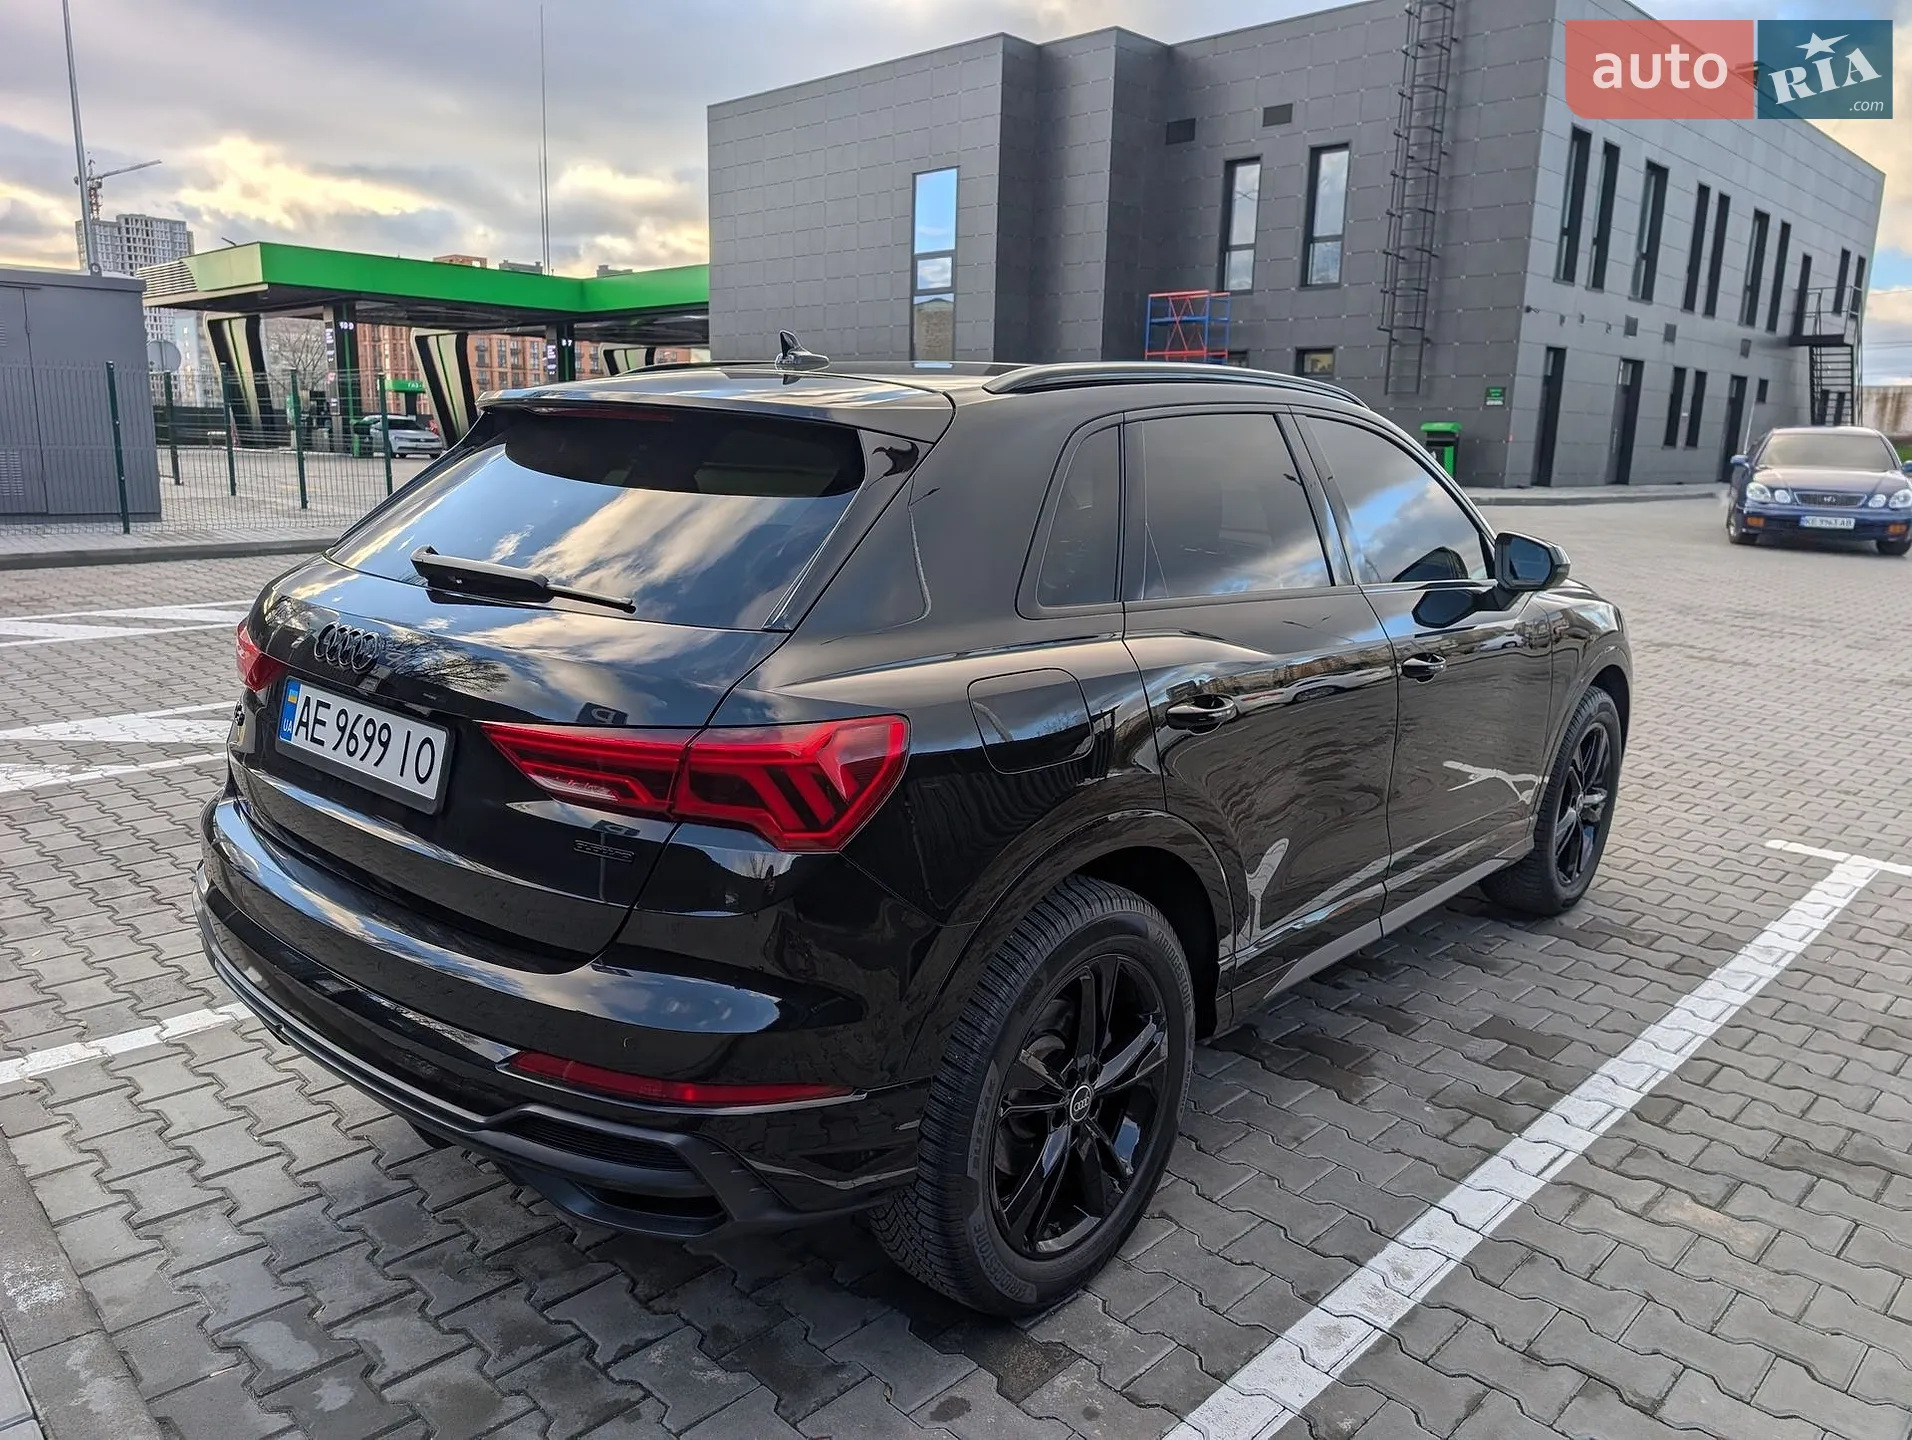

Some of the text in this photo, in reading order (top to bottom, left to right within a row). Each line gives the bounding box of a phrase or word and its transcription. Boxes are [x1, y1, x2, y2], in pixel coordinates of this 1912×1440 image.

[282, 718, 293, 734] UA
[295, 696, 331, 746] AE
[332, 708, 392, 767] 9699
